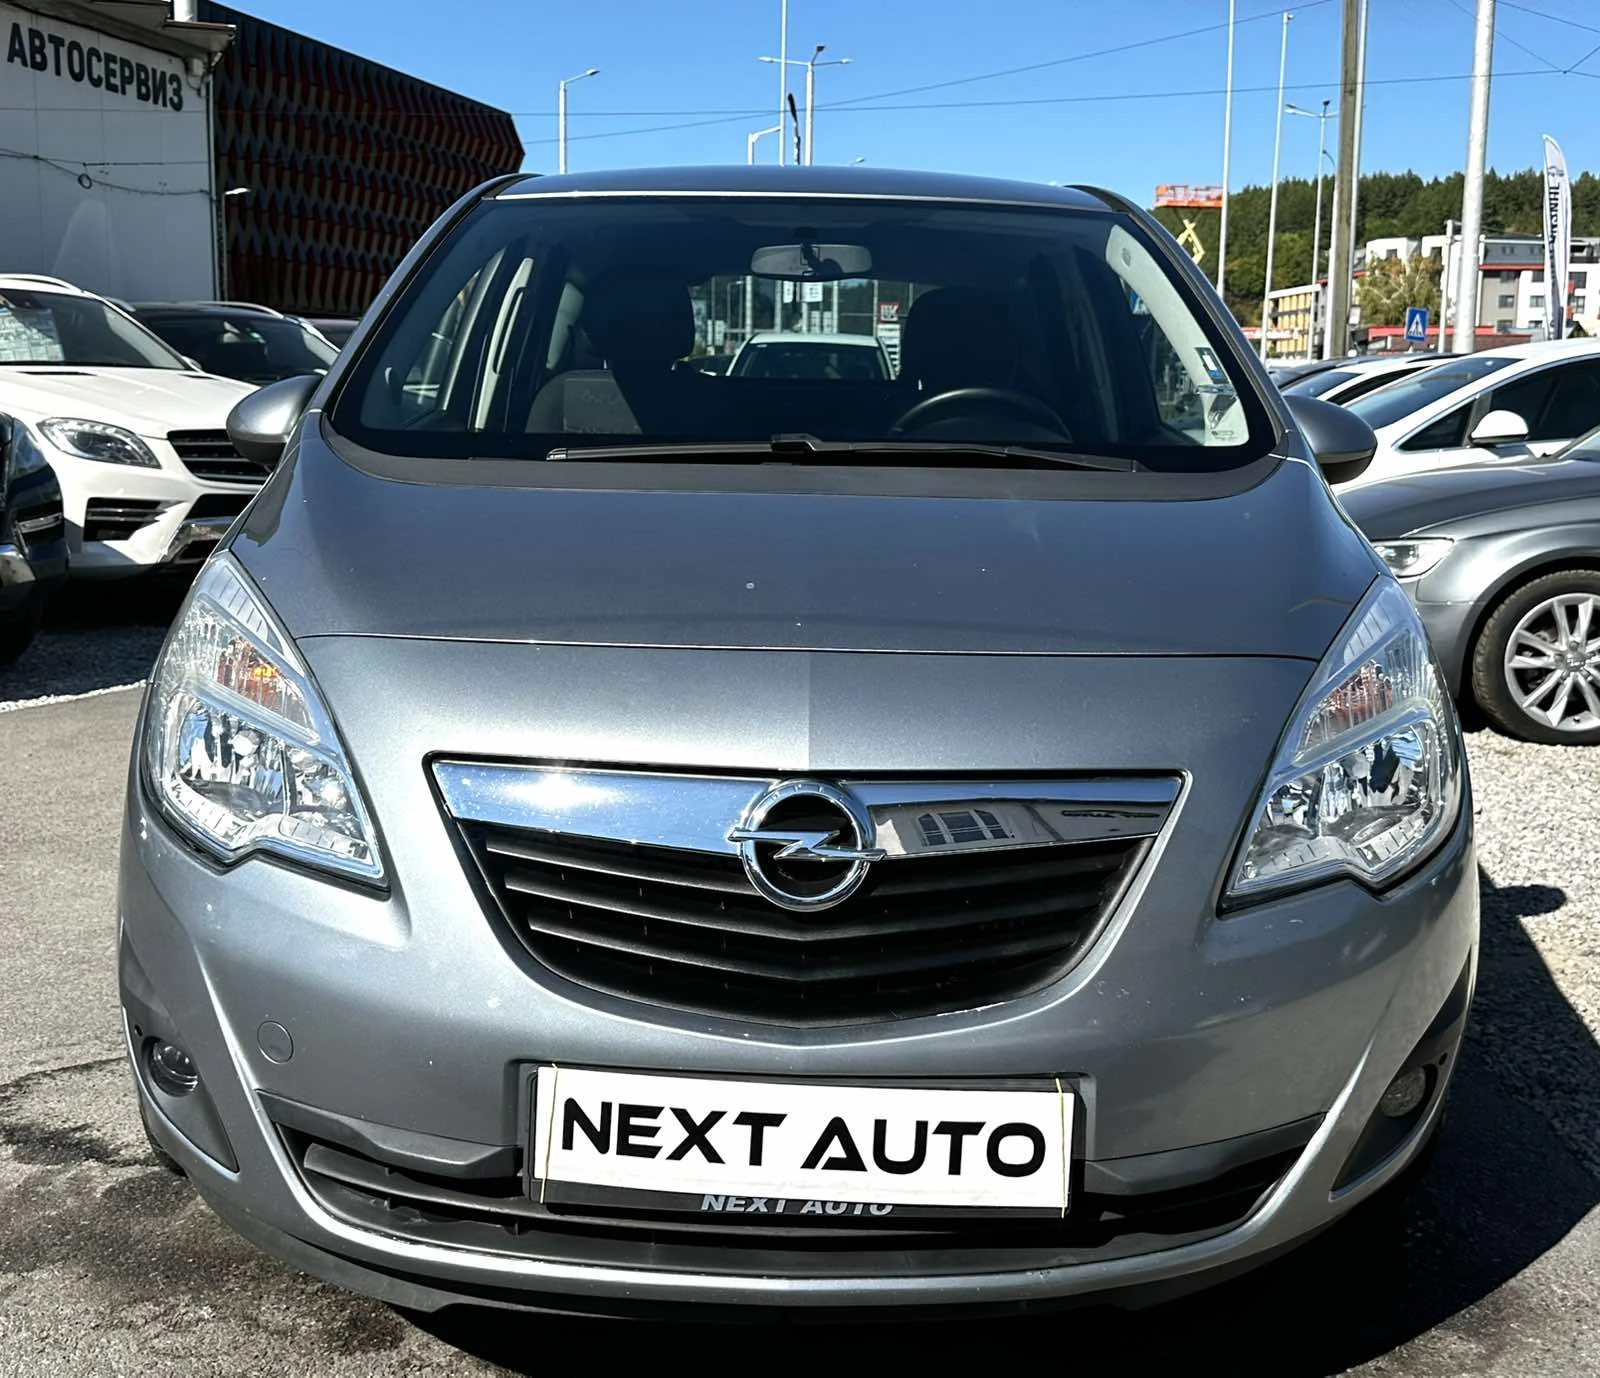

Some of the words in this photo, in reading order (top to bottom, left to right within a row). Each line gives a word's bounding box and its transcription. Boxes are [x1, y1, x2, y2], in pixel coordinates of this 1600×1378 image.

[7, 22, 183, 112] АВТОСЕРВИЗ
[561, 1097, 788, 1167] NEXT
[800, 1116, 1047, 1178] AUTO
